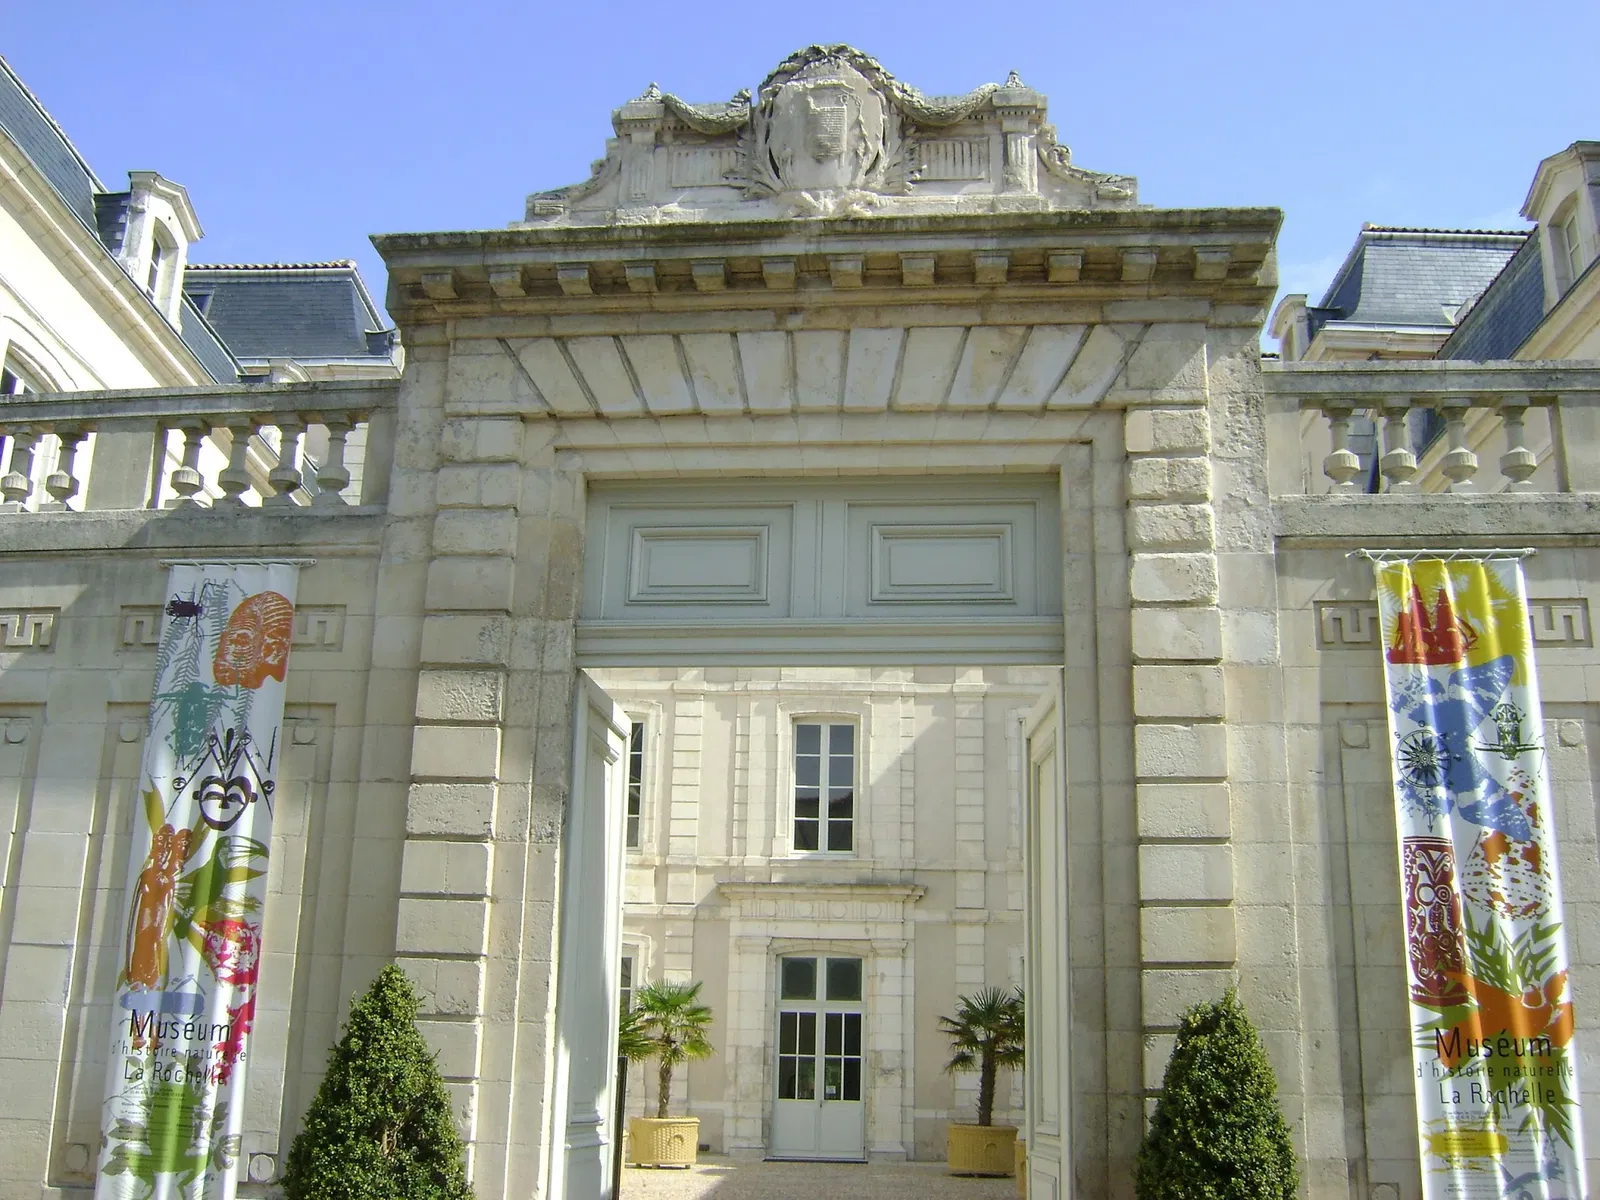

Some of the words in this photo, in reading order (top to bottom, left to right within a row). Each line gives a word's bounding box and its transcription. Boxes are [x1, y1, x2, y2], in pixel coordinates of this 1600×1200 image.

[129, 1009, 230, 1042] Muséum
[1434, 1027, 1552, 1058] Muséum
[124, 1059, 144, 1081] La
[152, 1061, 226, 1085] Rochelle
[1417, 1062, 1494, 1078] d'histoire
[1503, 1060, 1574, 1077] naturelle
[1439, 1082, 1460, 1105] La
[1470, 1081, 1556, 1105] Rochelle
